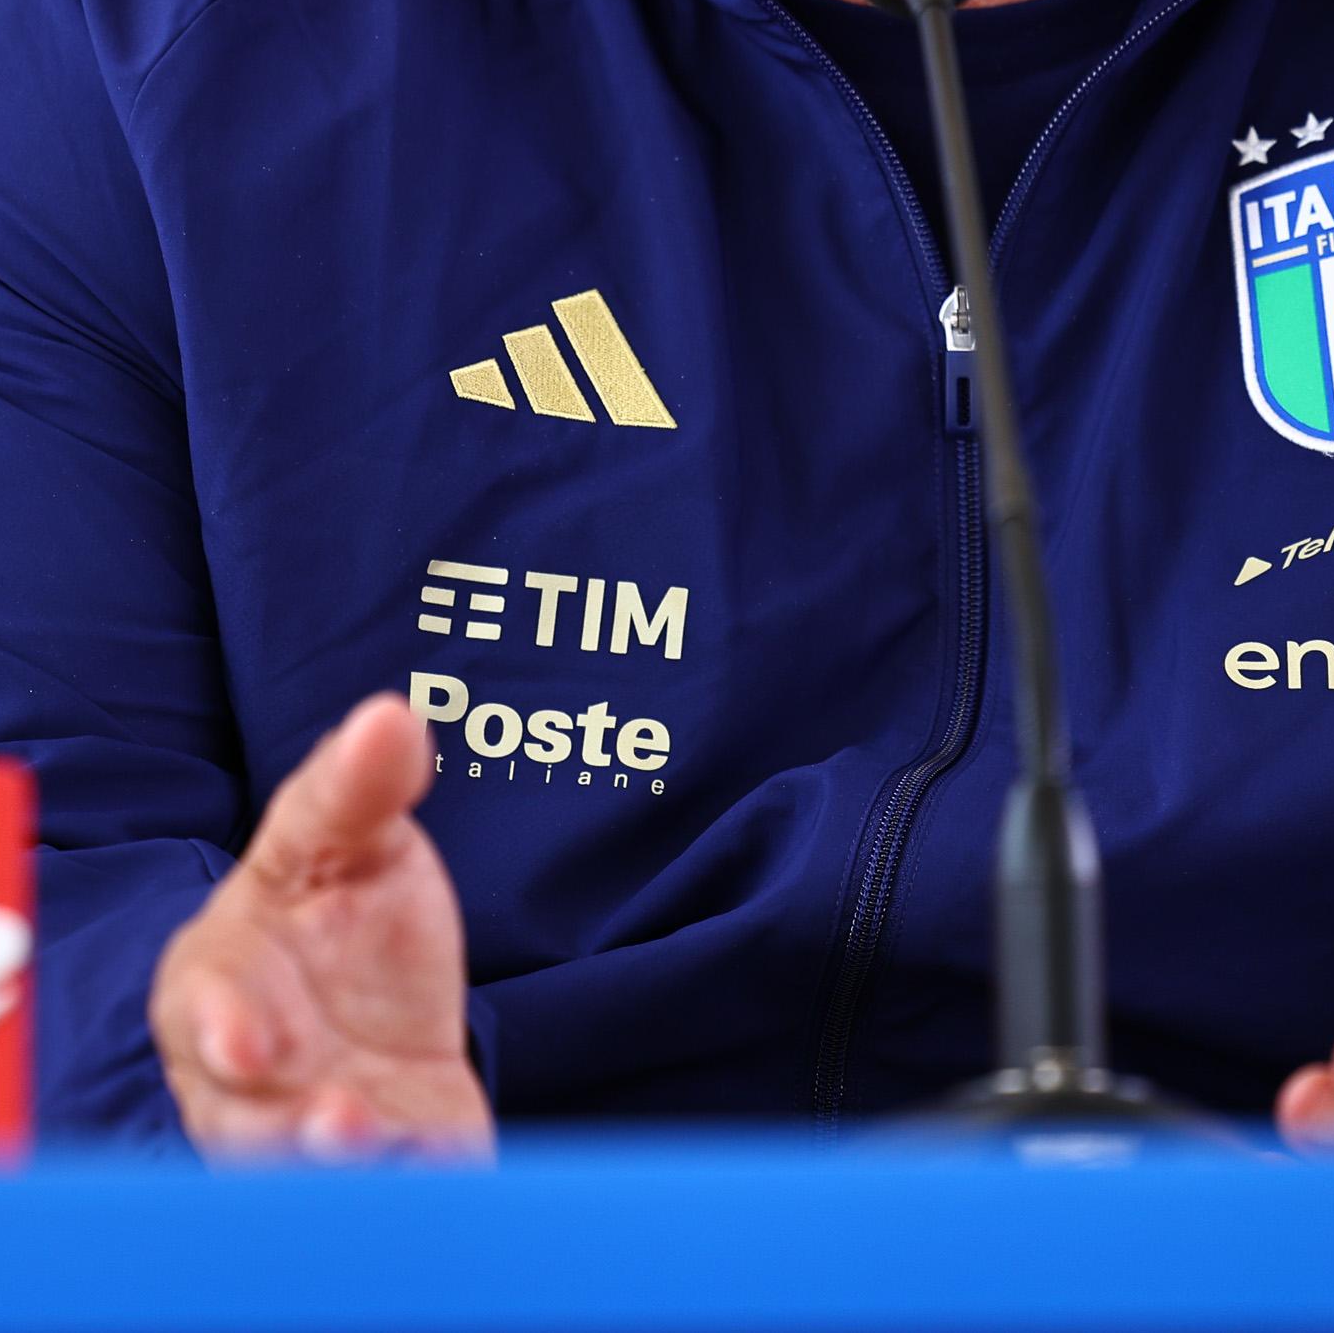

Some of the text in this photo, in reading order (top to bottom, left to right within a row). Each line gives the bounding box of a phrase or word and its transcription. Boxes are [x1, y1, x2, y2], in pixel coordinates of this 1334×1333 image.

[524, 571, 689, 660] TIM
[409, 672, 670, 770] Poste
[433, 752, 666, 796] taliane
